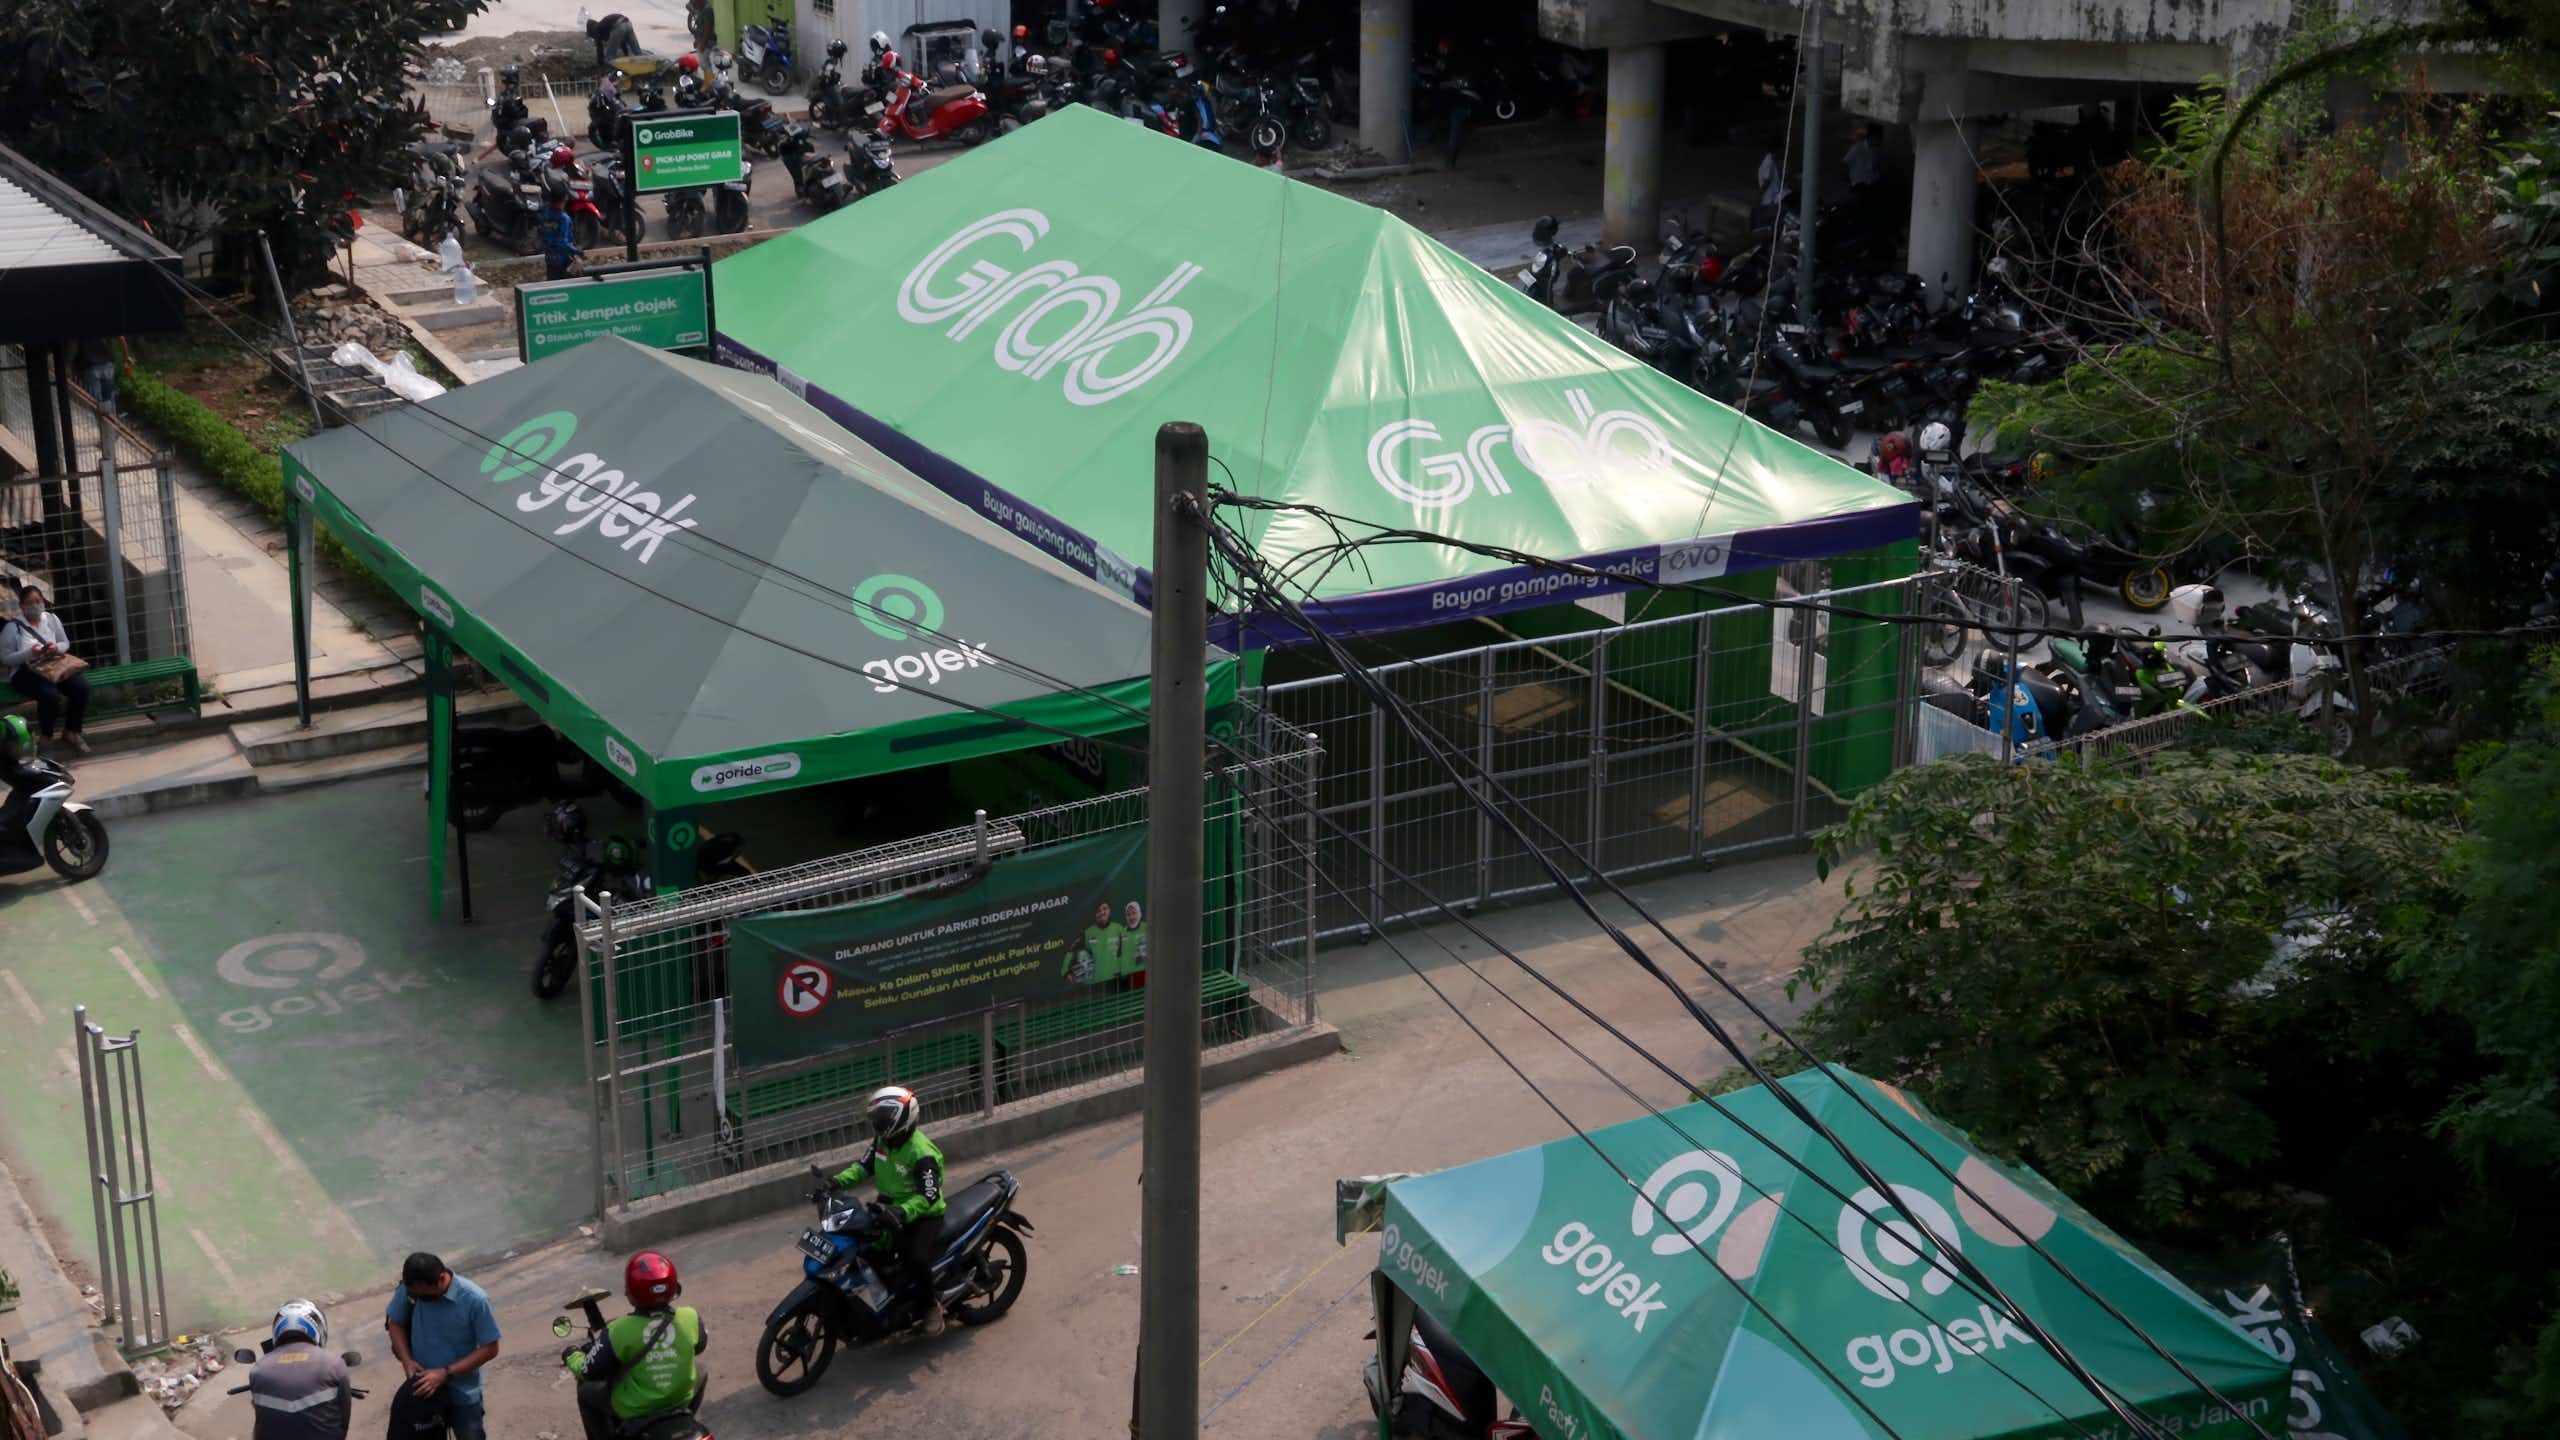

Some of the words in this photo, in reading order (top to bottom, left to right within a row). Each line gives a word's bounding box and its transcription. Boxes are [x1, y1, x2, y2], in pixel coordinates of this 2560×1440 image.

[654, 128, 694, 140] GrabBike
[655, 154, 686, 164] PICK-UP
[711, 150, 732, 160] GRAB
[533, 311, 567, 326] Titik
[571, 304, 631, 321] Jemput
[634, 297, 678, 314] Gojek
[897, 208, 1203, 406] Grab
[1367, 388, 1673, 508] Grab
[517, 453, 698, 564] gojek
[983, 489, 1014, 520] Bayar
[1015, 511, 1064, 556] gampang
[1432, 584, 1495, 611] Bayar
[862, 639, 1000, 693] gojek
[715, 757, 763, 785] goride
[835, 939, 895, 960] DILARANG
[896, 929, 935, 946] UNTUK
[936, 917, 979, 935] PARKIR
[981, 905, 1030, 925] DIDEPAN
[1031, 895, 1069, 913] PAGAR
[895, 972, 930, 987] Dalam
[931, 961, 972, 978] Shelter
[974, 952, 1006, 968] untuk
[1008, 943, 1041, 959] Parkir
[1043, 938, 1065, 951] dan
[901, 983, 950, 1001] Gunakan
[952, 971, 992, 989] Atribut
[993, 960, 1041, 977] Lengkap
[218, 970, 432, 1034] gojek
[1398, 1240, 1449, 1301] gojek
[1541, 1221, 1667, 1334] gojek
[1846, 1303, 2037, 1388] gojek
